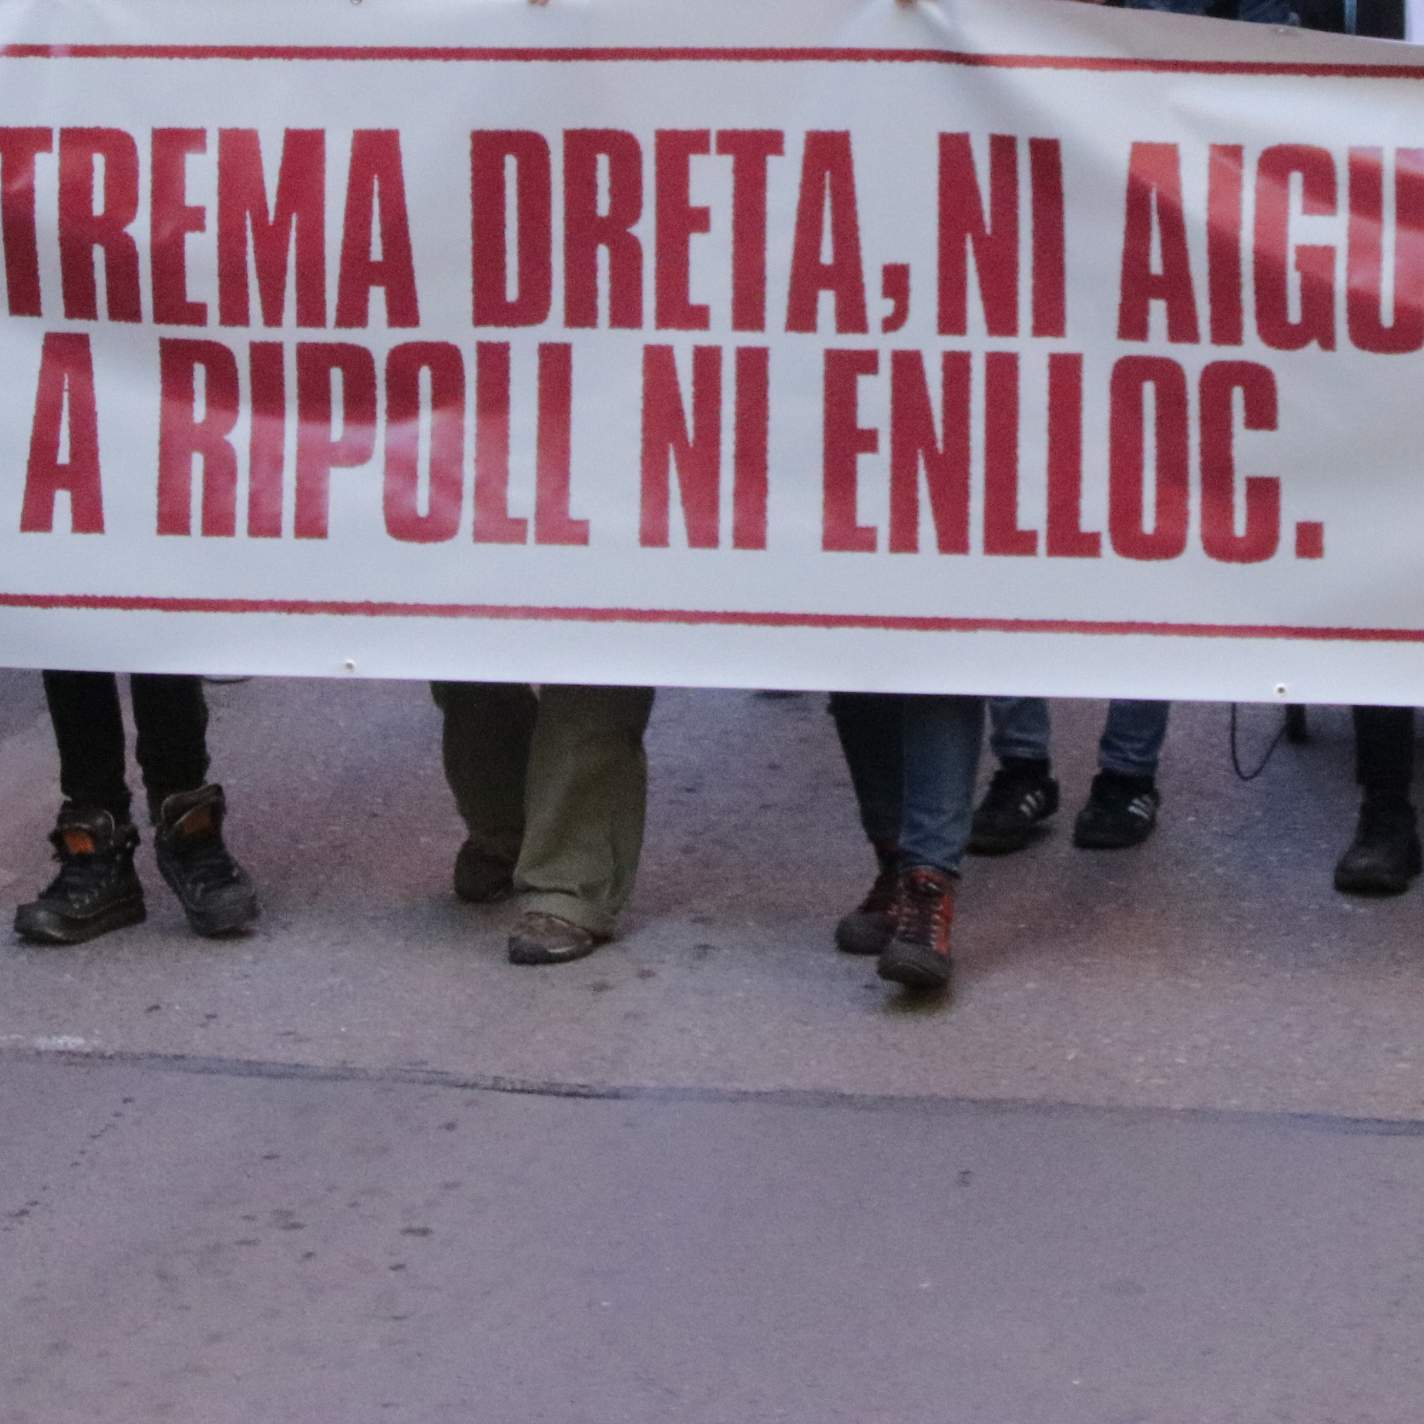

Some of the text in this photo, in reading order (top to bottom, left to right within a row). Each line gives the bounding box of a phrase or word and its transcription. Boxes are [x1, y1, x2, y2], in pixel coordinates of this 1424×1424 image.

[470, 128, 910, 334] DRETA,
[937, 132, 1066, 338] NI
[20, 332, 105, 534] A
[157, 337, 590, 545] RIPOLL
[640, 344, 770, 551] NI
[821, 348, 1324, 564] ENLLOC.
